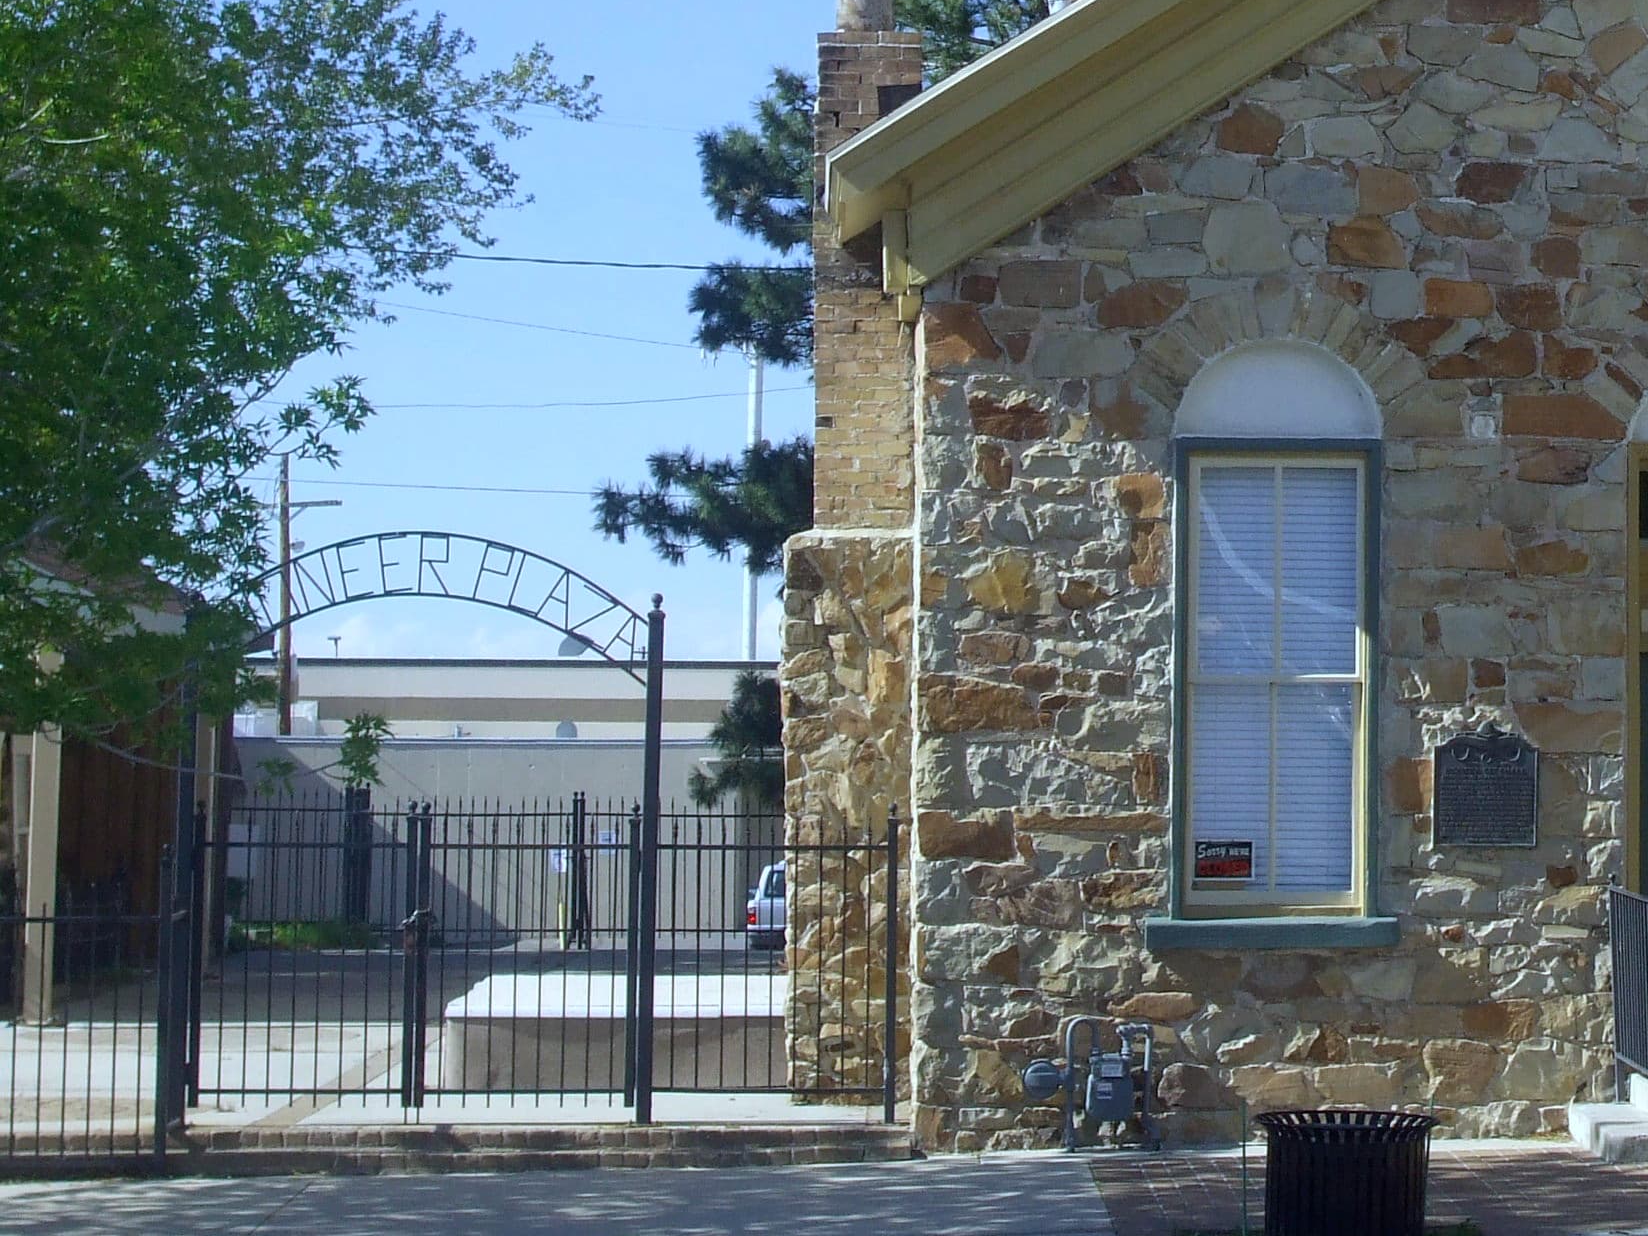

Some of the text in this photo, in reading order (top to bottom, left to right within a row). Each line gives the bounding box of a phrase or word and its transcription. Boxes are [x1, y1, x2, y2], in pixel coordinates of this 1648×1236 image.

[240, 533, 637, 673] IONEER PLAZA
[1197, 844, 1226, 858] Sorry
